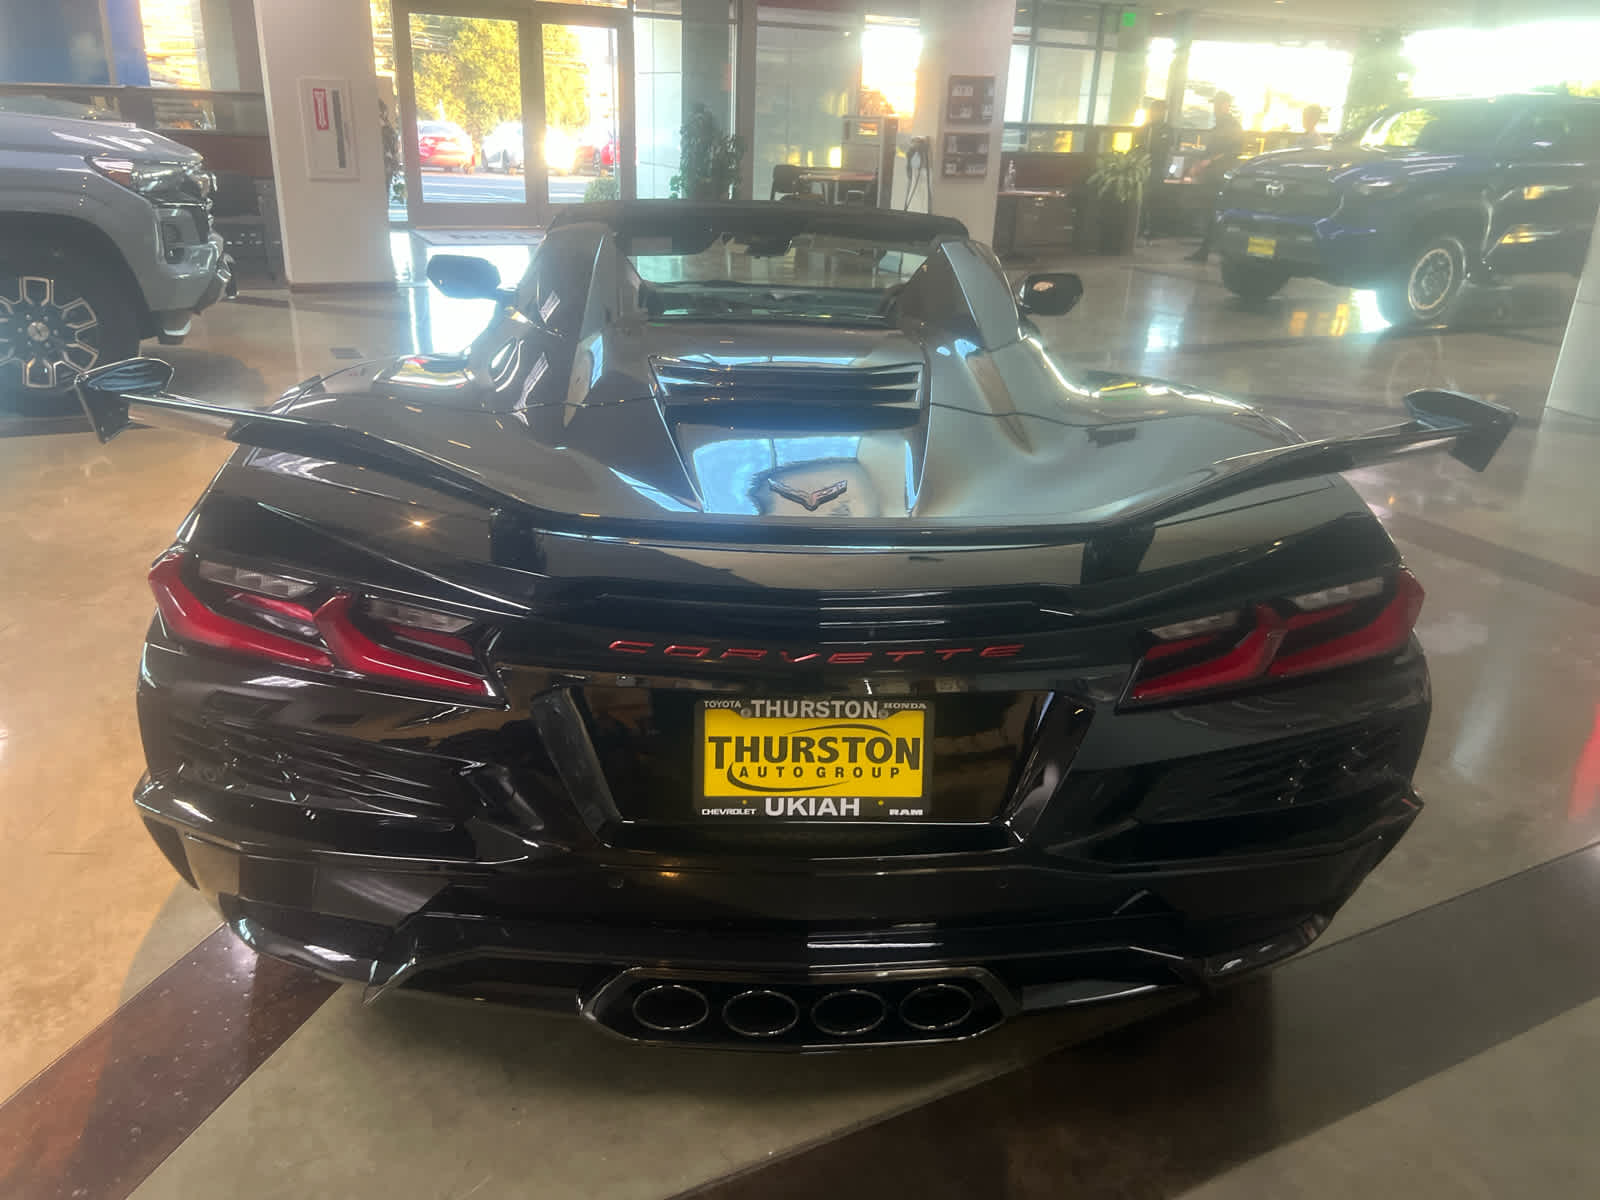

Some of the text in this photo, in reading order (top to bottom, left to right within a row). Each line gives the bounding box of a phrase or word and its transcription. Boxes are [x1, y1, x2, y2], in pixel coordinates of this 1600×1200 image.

[609, 640, 1025, 664] CORVETTE
[704, 700, 741, 708] TOYOTA
[751, 700, 878, 718] THURSTON
[708, 736, 921, 770] THURSTON
[739, 767, 900, 778] AUTO GROUP
[765, 798, 860, 816] UKIAH
